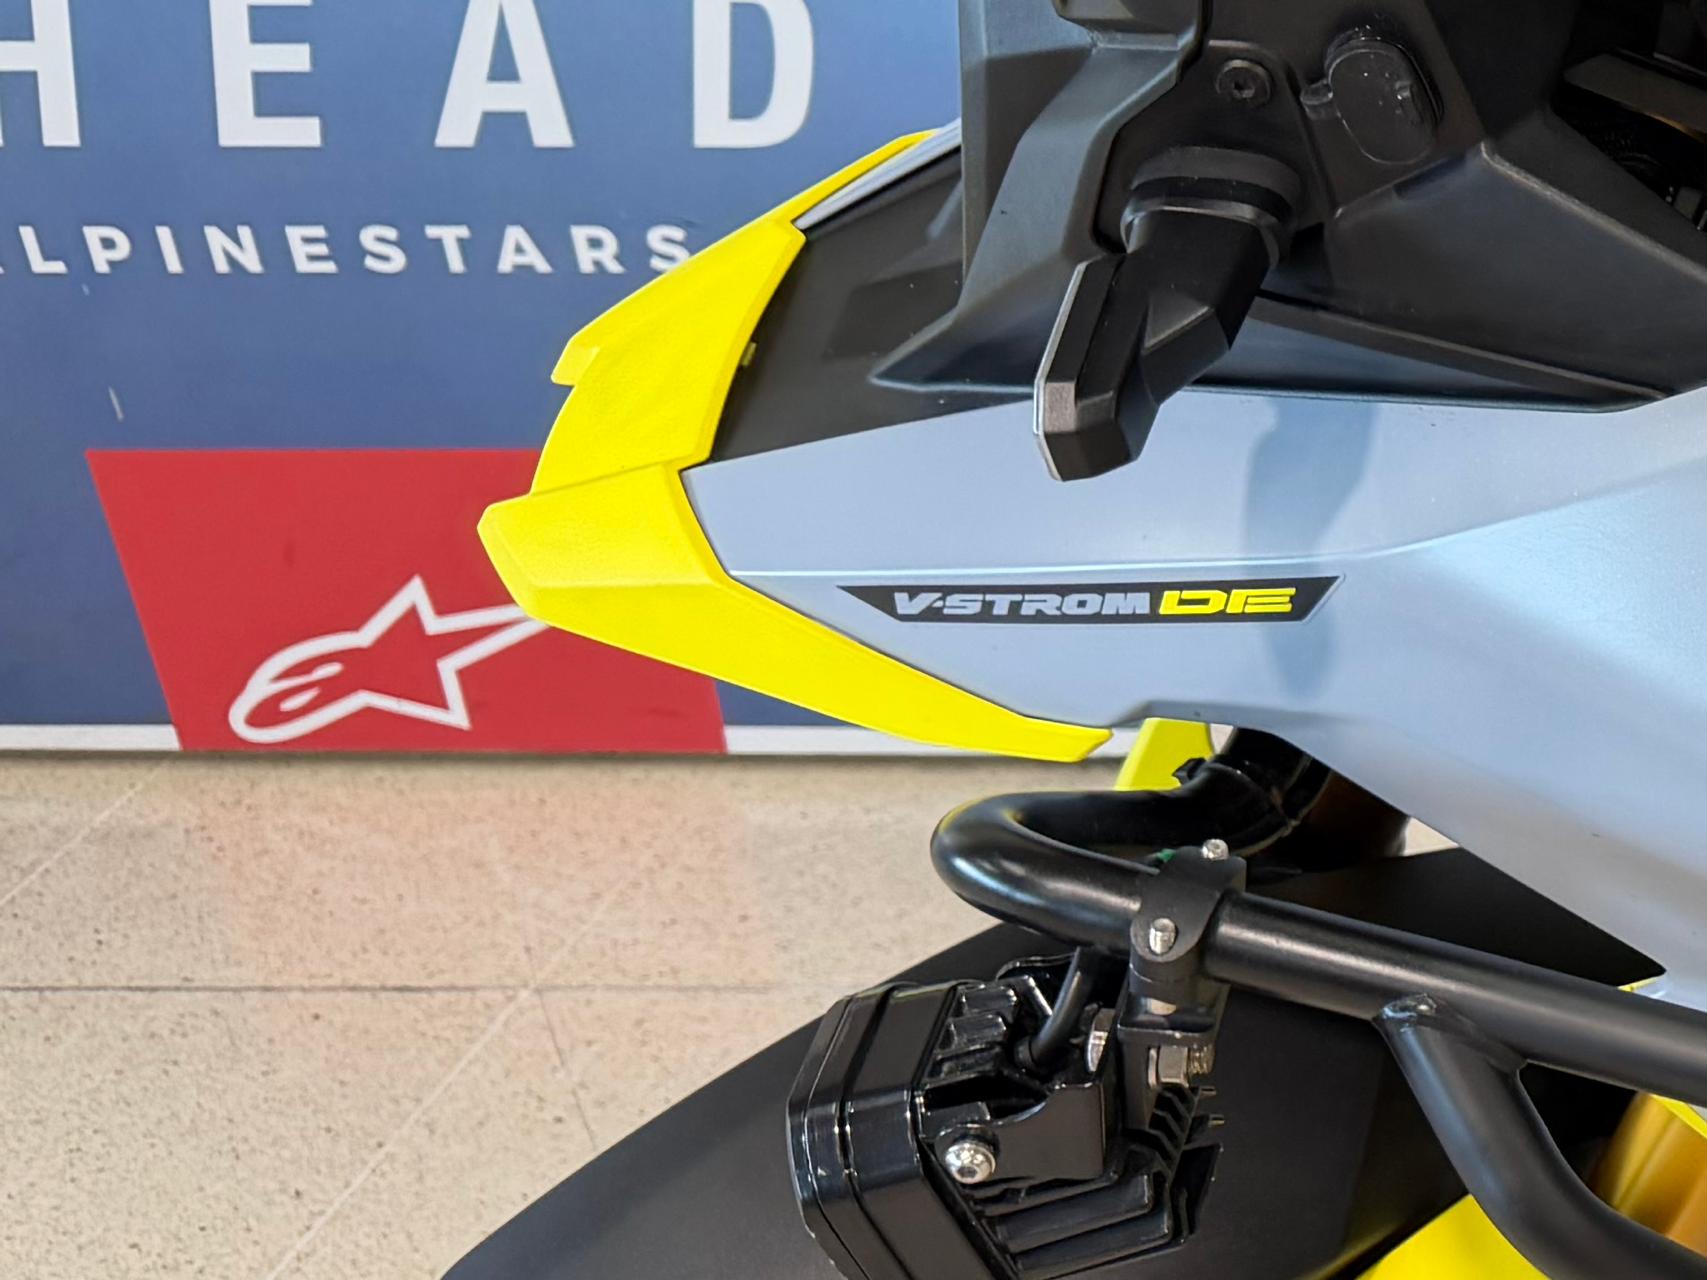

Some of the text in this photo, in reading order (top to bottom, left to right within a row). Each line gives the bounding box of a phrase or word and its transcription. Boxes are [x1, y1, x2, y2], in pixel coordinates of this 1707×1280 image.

[0, 225, 691, 276] LPINESTARS
[893, 587, 1294, 618] V-STROM DE
